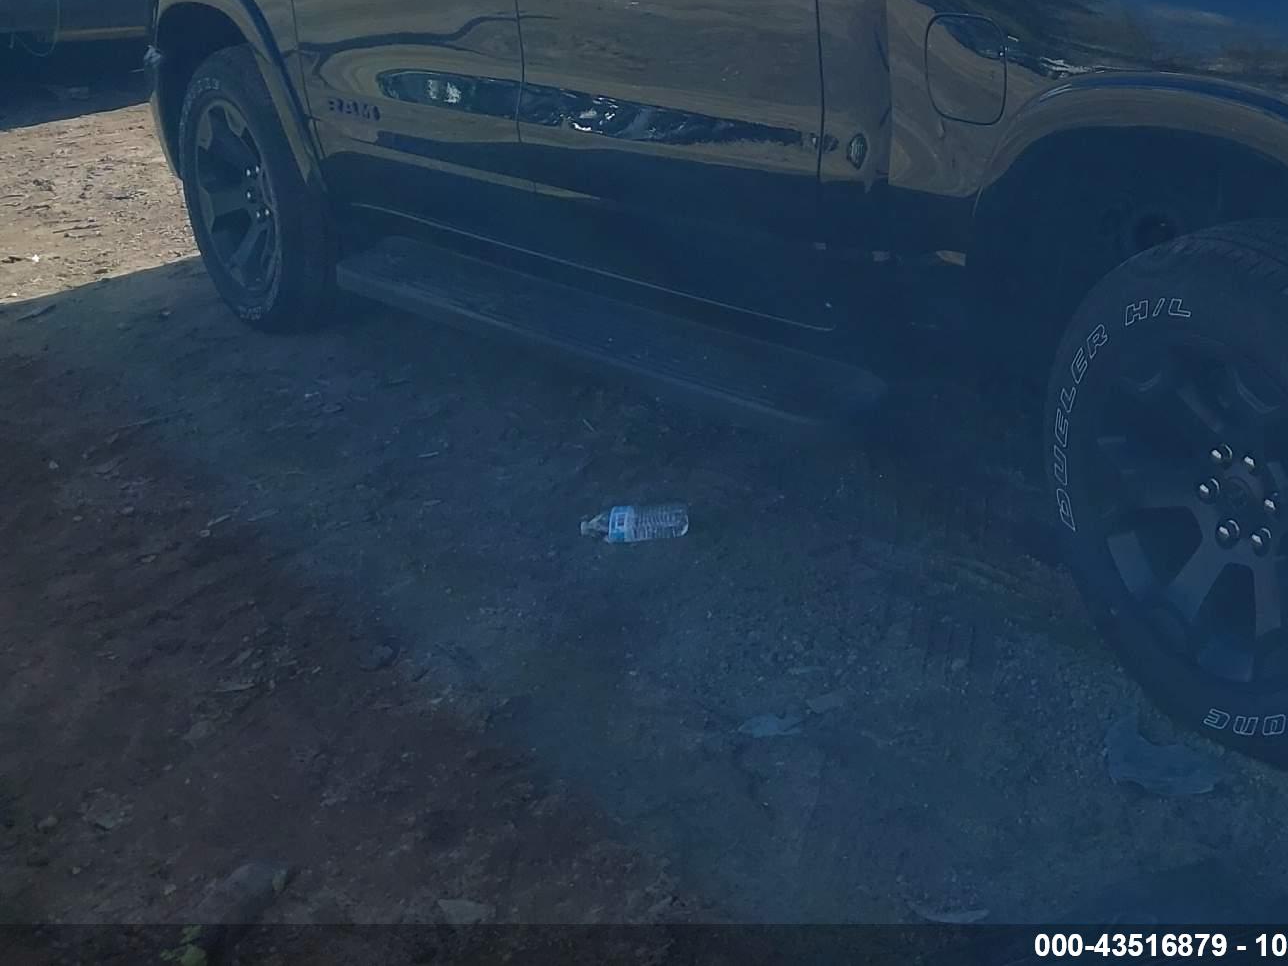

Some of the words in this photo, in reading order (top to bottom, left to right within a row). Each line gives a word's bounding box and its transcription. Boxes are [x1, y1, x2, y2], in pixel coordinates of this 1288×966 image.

[326, 97, 381, 121] RAM
[1054, 323, 1108, 532] DUELER
[1125, 298, 1191, 326] H/L
